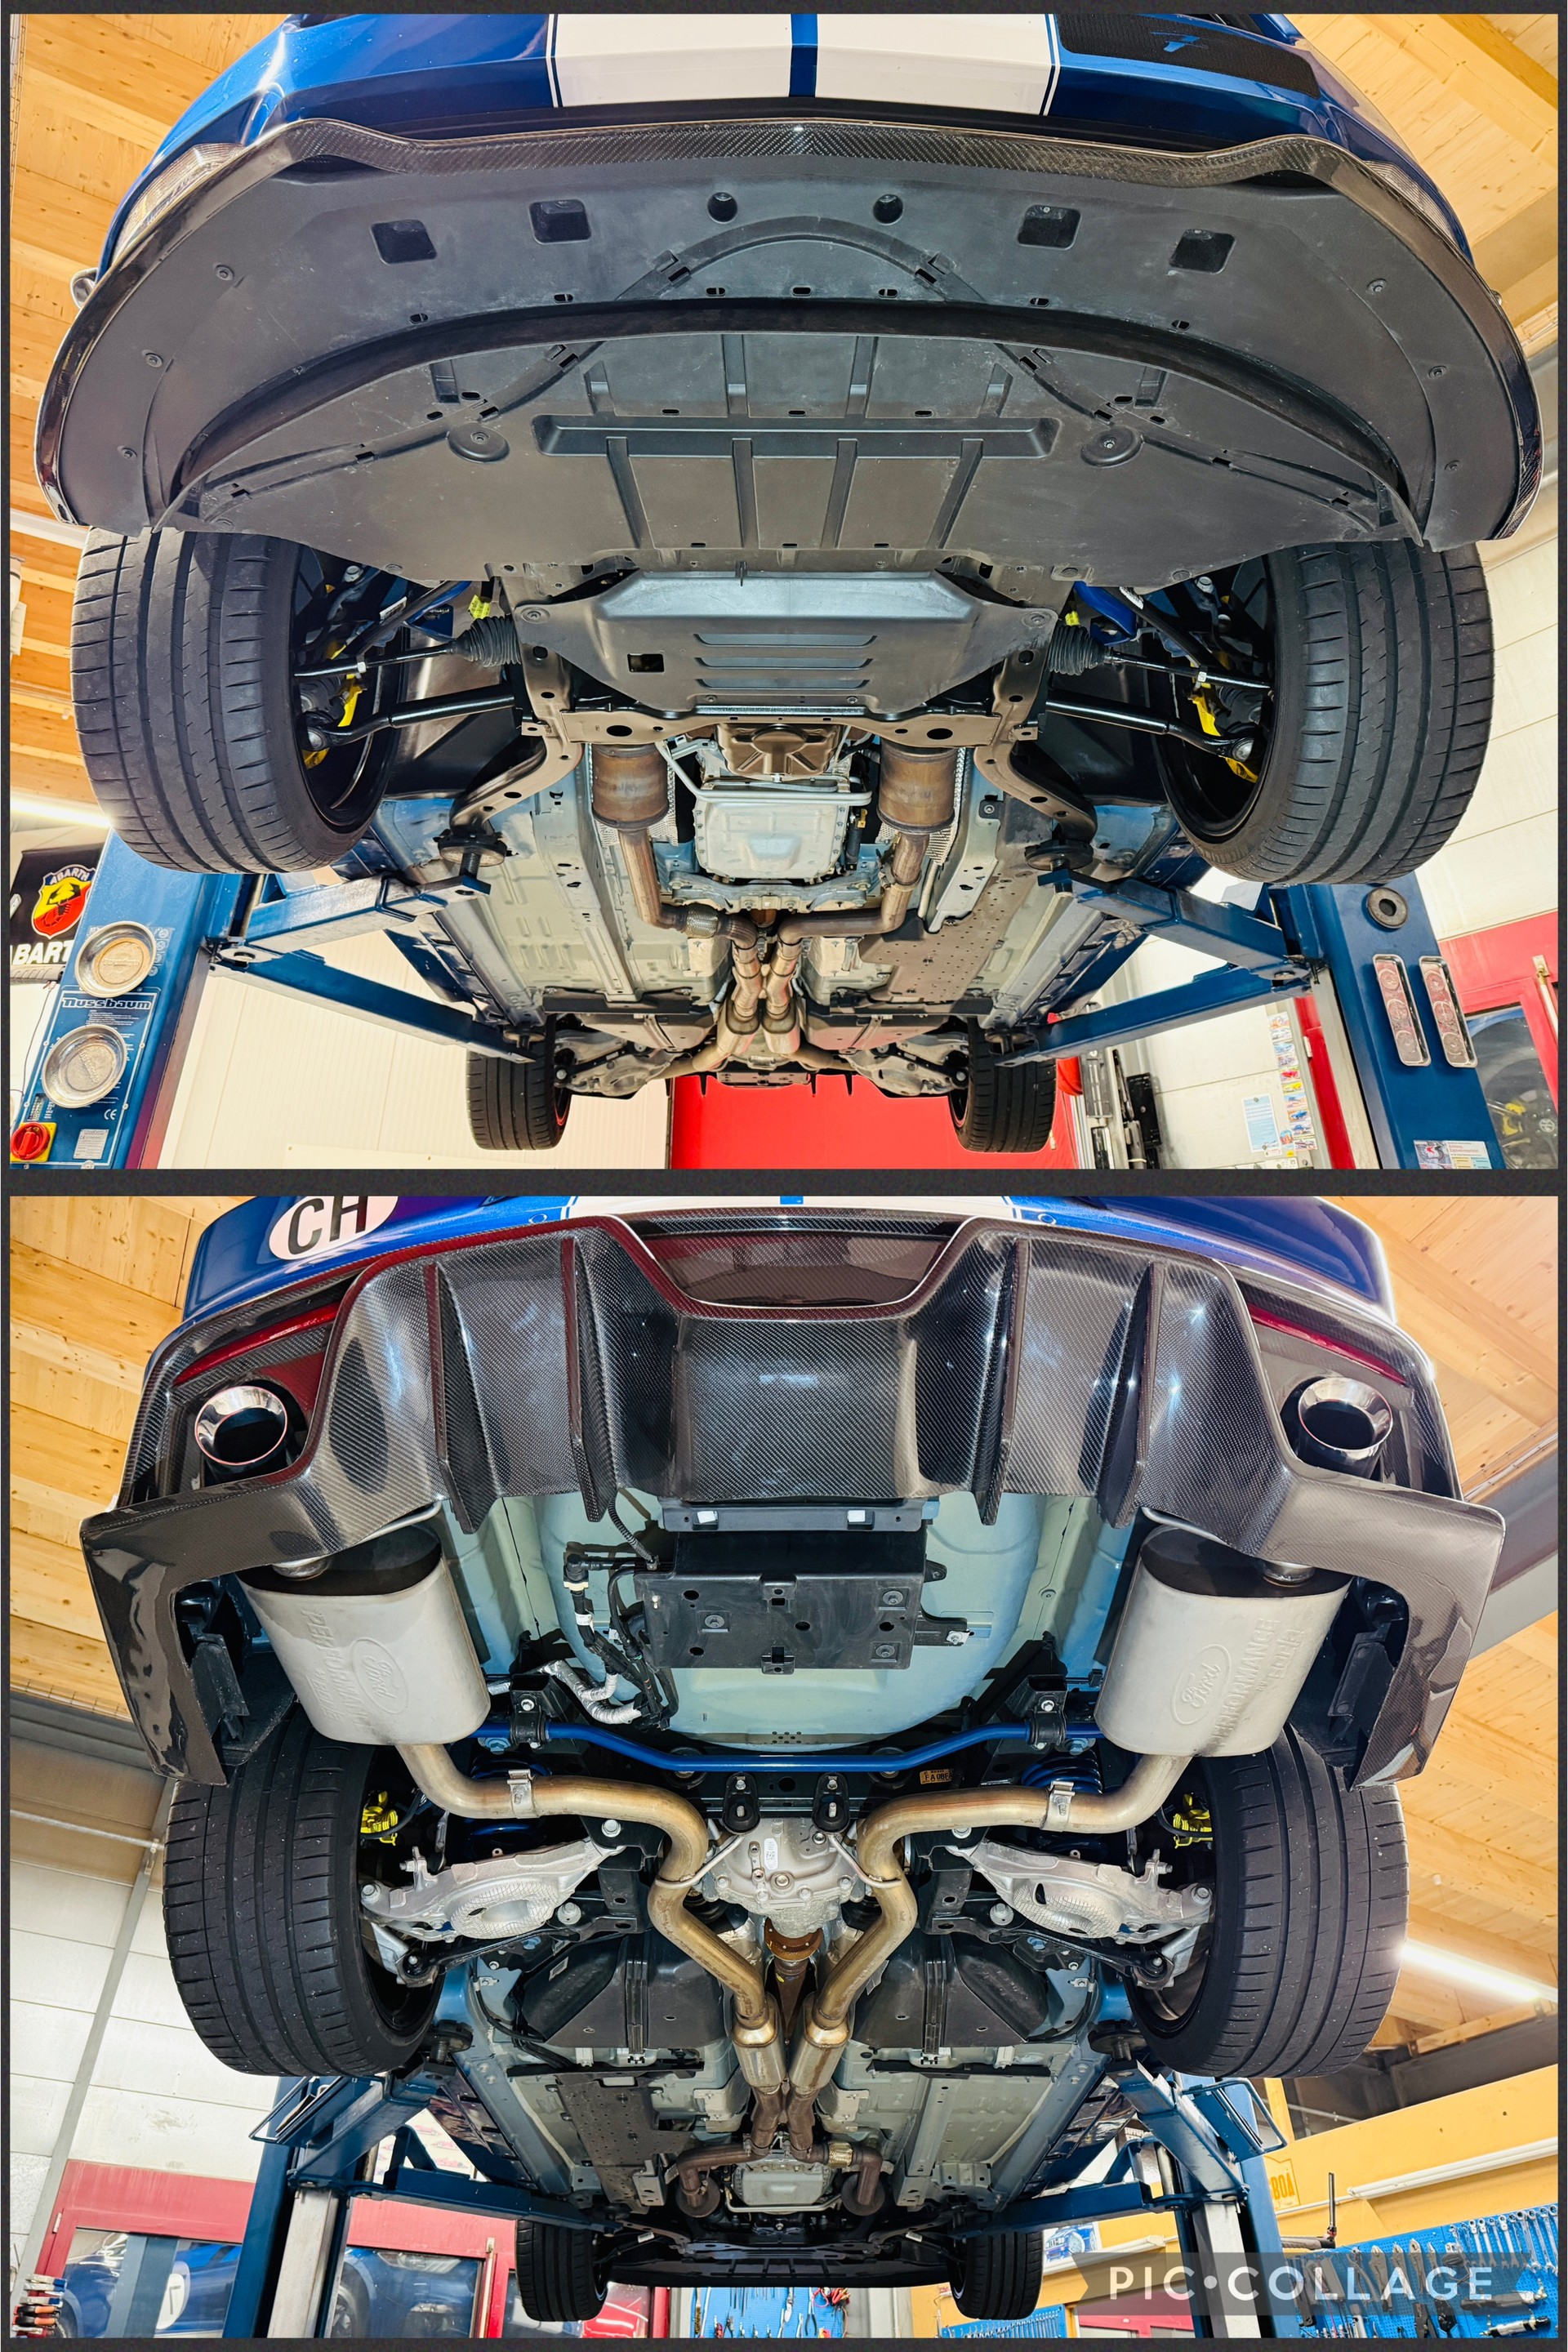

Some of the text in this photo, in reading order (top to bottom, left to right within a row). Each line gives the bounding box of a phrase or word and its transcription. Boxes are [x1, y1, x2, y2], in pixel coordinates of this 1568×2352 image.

[50, 867, 90, 885] ABARTH
[10, 940, 74, 965] BART
[288, 1196, 368, 1255] CH
[362, 1655, 398, 1699] Ford
[1181, 1663, 1222, 1708] Ford
